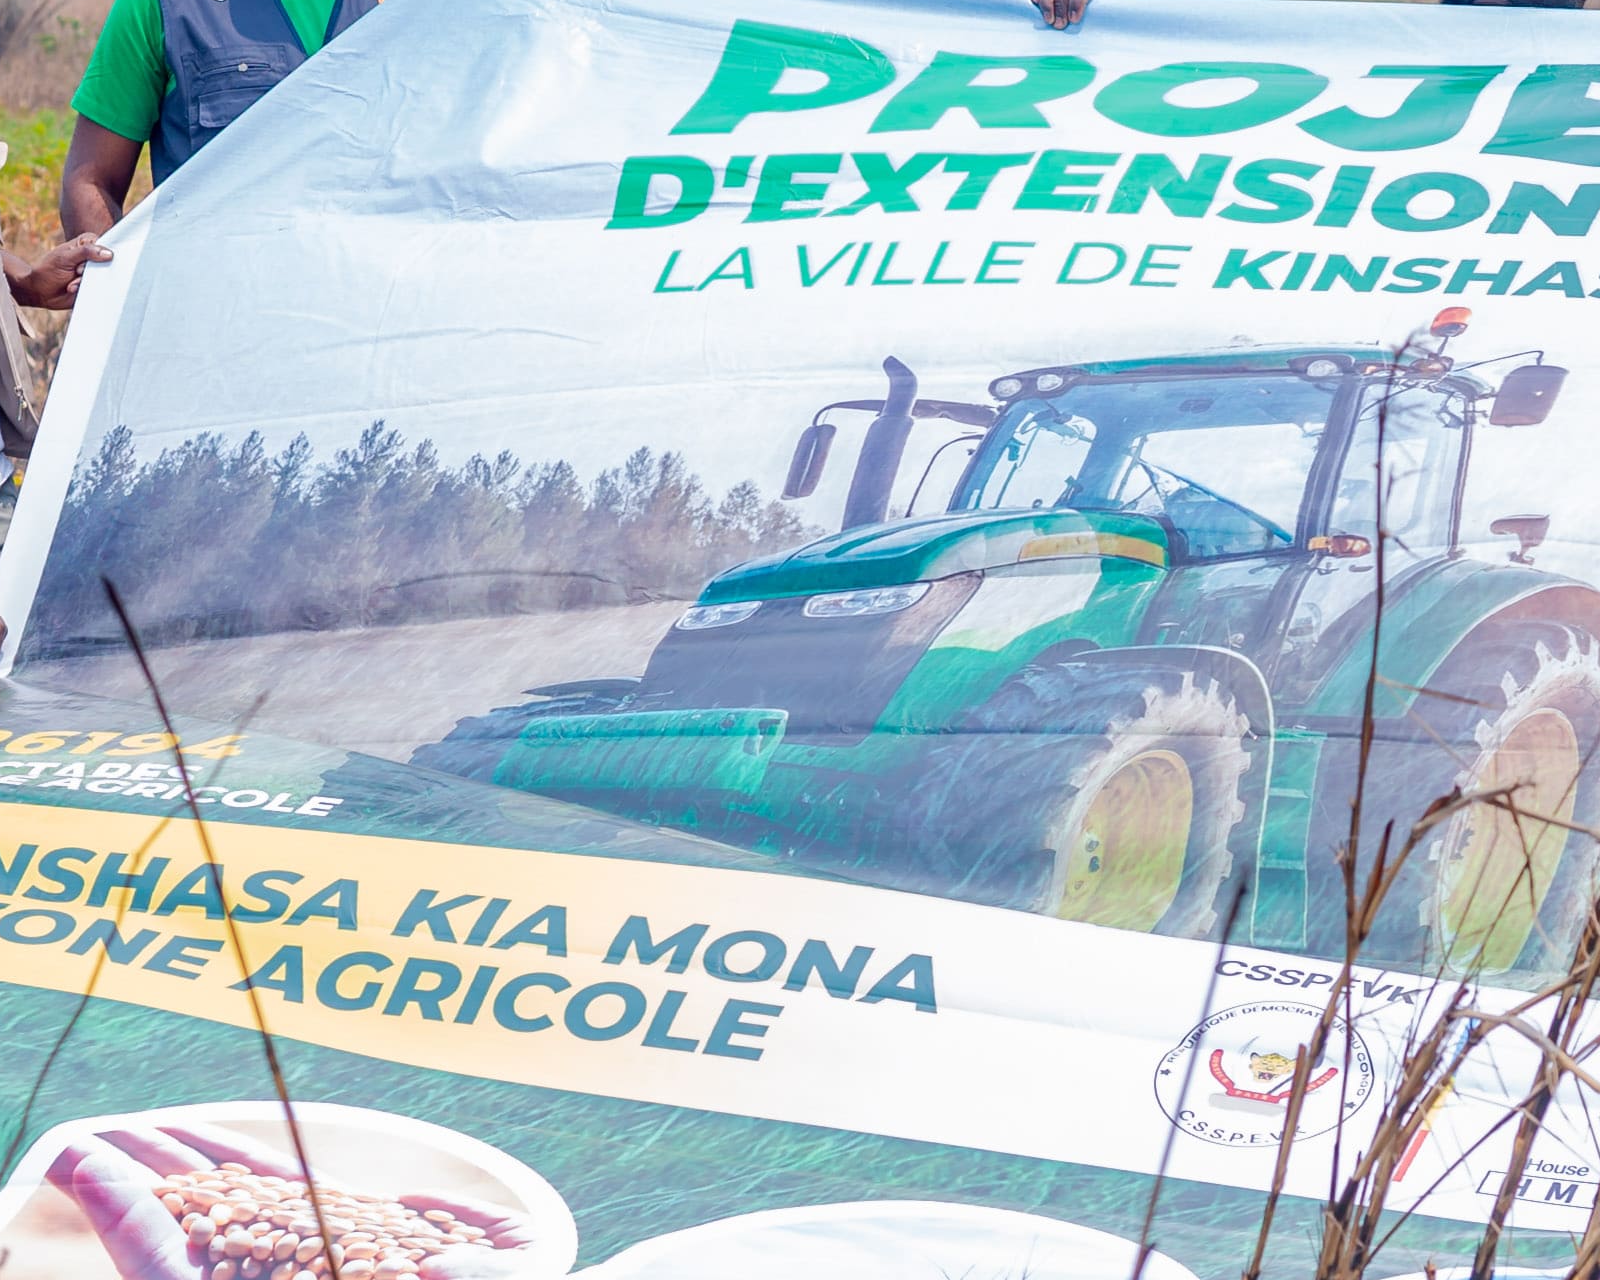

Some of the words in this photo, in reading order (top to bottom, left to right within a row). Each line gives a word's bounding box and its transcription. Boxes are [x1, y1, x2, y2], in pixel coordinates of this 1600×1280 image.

[653, 248, 757, 294] LA
[796, 240, 1037, 288] VILLE
[1055, 242, 1190, 289] DE
[38, 775, 345, 817] AGRICOLE
[392, 887, 569, 955] KIA
[600, 914, 939, 1016] MONA
[241, 944, 785, 1062] AGRICOLE
[1525, 1158, 1590, 1178] House
